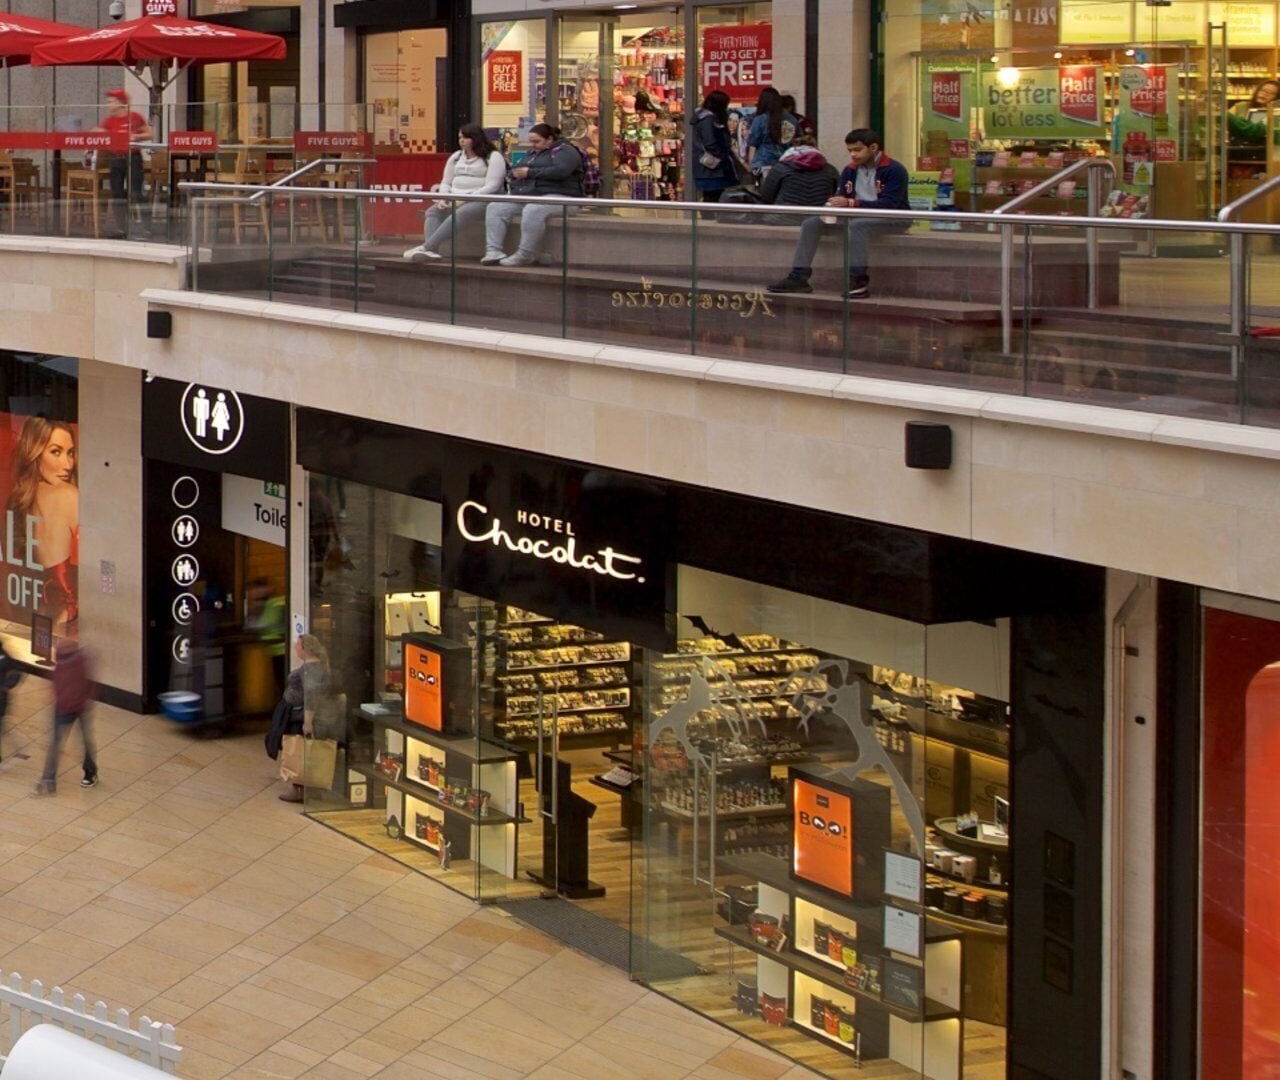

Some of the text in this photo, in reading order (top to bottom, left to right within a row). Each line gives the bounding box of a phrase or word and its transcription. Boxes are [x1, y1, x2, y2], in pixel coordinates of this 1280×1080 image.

[146, 3, 175, 13] GUYS
[719, 34, 759, 49] EVERYTHING
[710, 48, 766, 60] BUY 3 GET 3
[493, 64, 517, 74] BUY 3
[704, 62, 773, 87] FREE
[493, 73, 517, 83] GET 3
[1061, 76, 1094, 91] Half
[493, 82, 517, 92] FREE
[932, 81, 958, 93] Half
[932, 92, 959, 103] Price
[989, 86, 1056, 106] better
[1061, 91, 1095, 103] Price
[992, 111, 1055, 127] lot less
[65, 137, 111, 145] FIVE GUYS
[308, 137, 358, 145] FIVE GUYS
[517, 509, 576, 536] HOTEL
[7, 573, 44, 610] OFF
